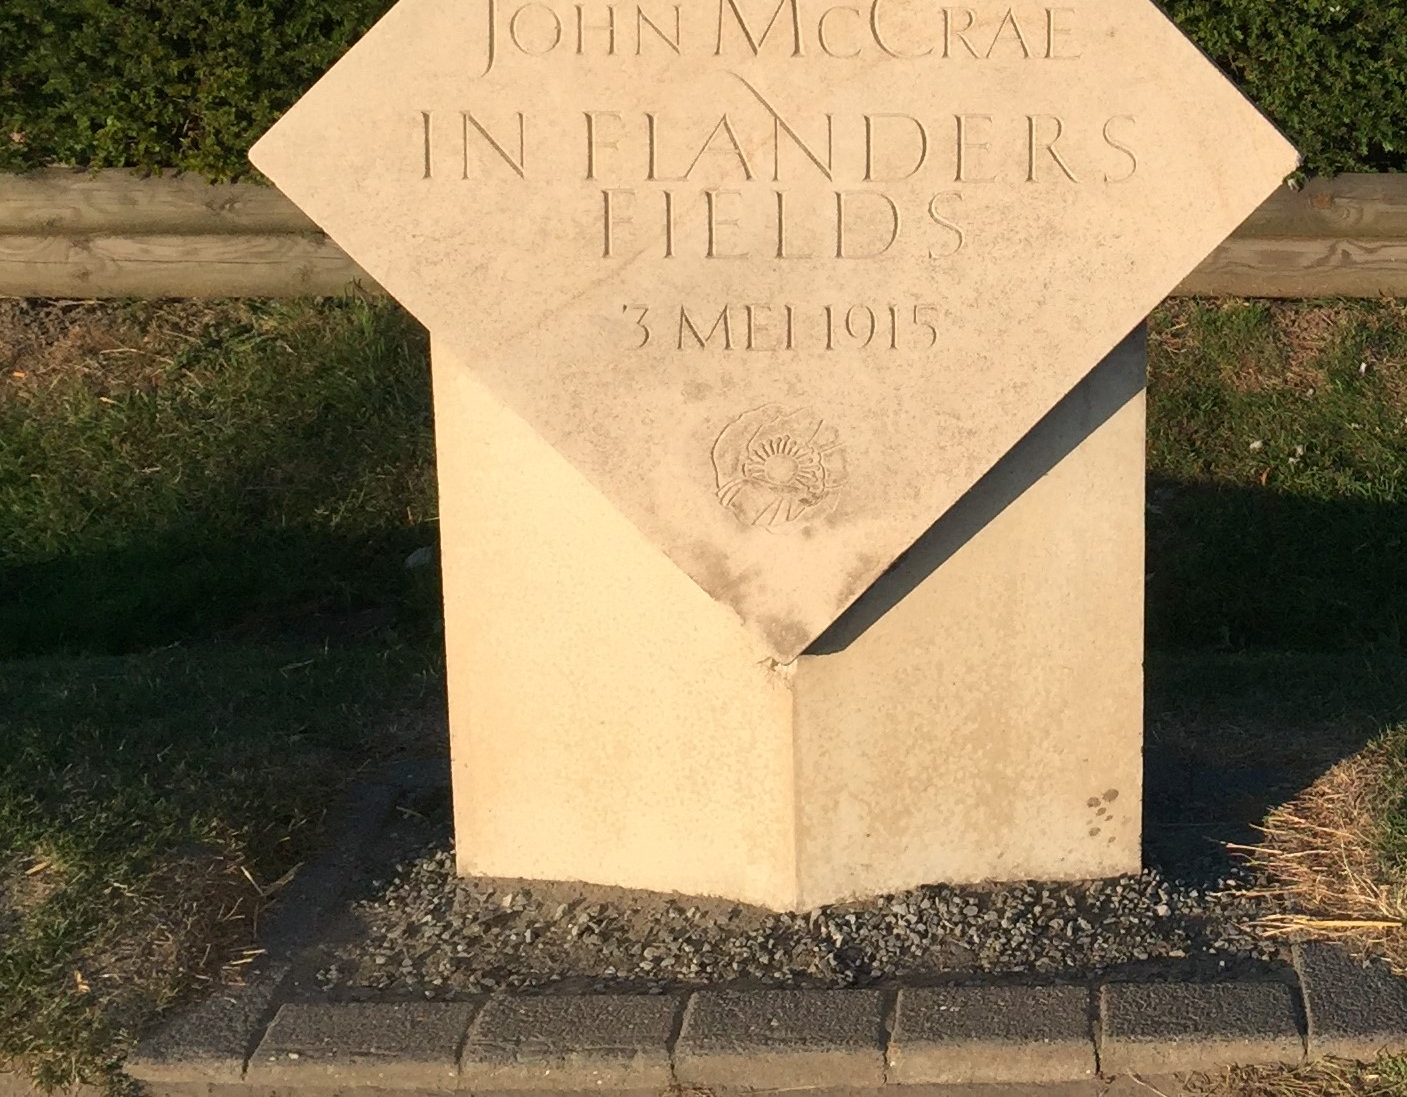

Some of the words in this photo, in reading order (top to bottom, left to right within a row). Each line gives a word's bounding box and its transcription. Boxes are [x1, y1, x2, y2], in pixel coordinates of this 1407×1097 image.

[422, 110, 527, 181] IN
[582, 72, 1139, 183] FLANDERS
[600, 188, 966, 260] FIELDS
[677, 304, 797, 352] MEI
[824, 303, 939, 352] 1915
